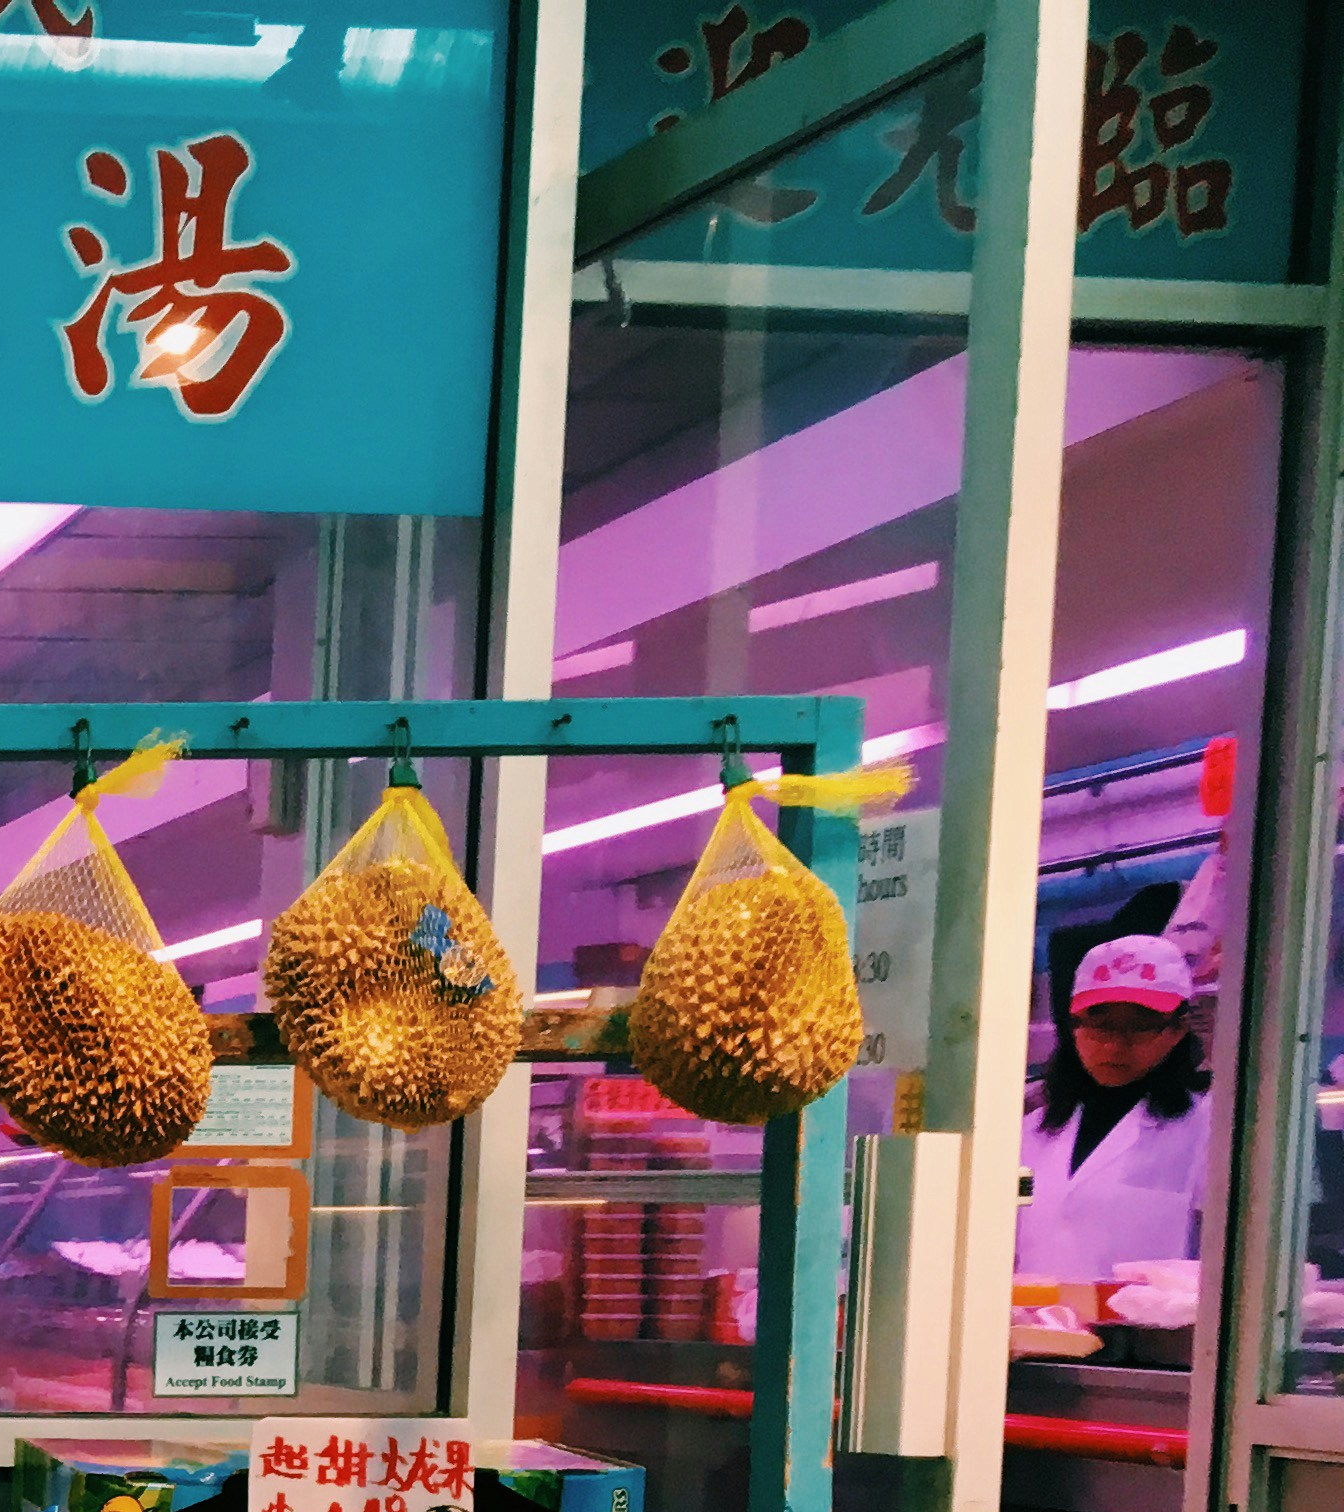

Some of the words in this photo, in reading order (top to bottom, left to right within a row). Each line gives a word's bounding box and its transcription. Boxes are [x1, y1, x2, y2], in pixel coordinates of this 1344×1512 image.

[173, 1318, 281, 1341] 本公司接受
[166, 1377, 207, 1390] Accept
[212, 1376, 242, 1388] Food
[246, 1376, 287, 1389] Stamp
